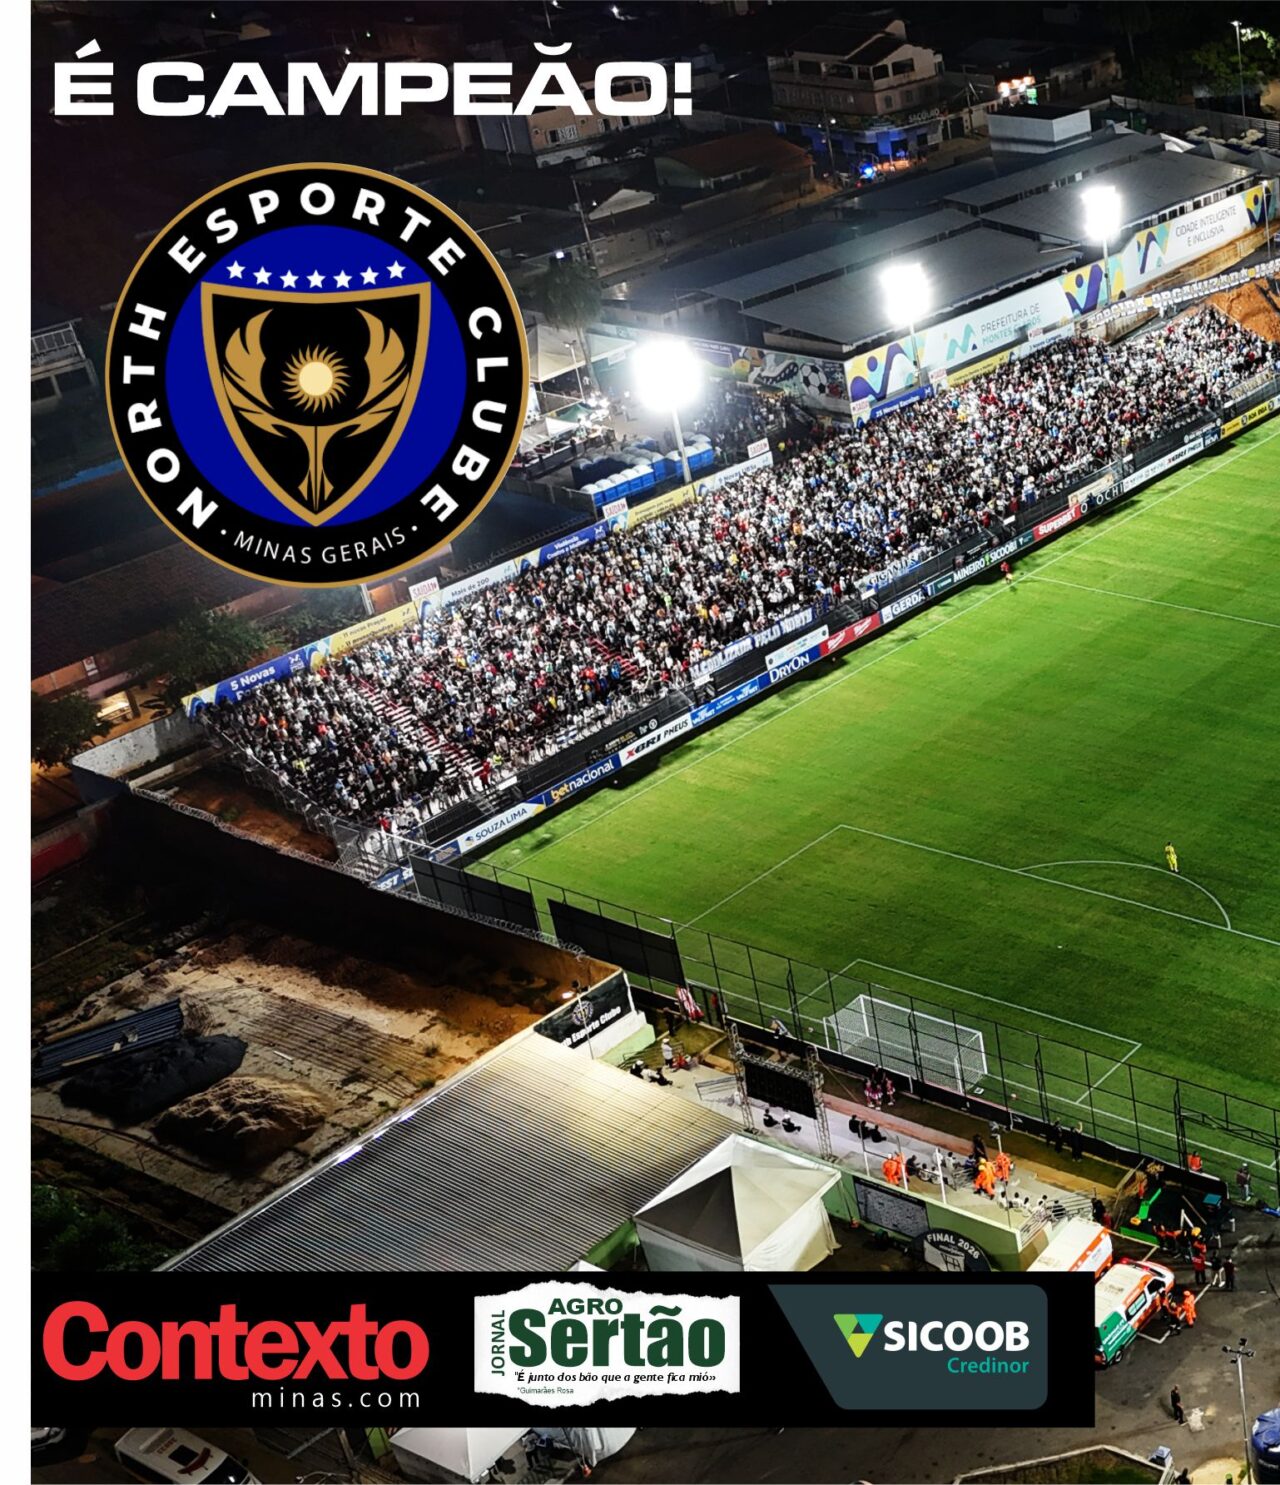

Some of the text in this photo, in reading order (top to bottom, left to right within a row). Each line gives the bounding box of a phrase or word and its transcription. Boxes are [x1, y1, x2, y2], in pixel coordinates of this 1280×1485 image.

[981, 309, 1028, 334] PREFEITURA
[1030, 302, 1040, 315] DE
[1080, 481, 1124, 514] OOCHI
[1038, 509, 1077, 536] SUPERBET
[953, 560, 985, 583] MINEIRO
[451, 588, 467, 597] Mais
[477, 577, 490, 587] 200
[230, 666, 276, 691] 5 Novas
[664, 719, 689, 738] PNEUS
[551, 758, 614, 802] betnacional
[475, 807, 528, 842] SOUZA LIMA
[571, 1020, 600, 1043] Esporte
[600, 1006, 621, 1024] Clube
[926, 1233, 980, 1260] FINAL 2026
